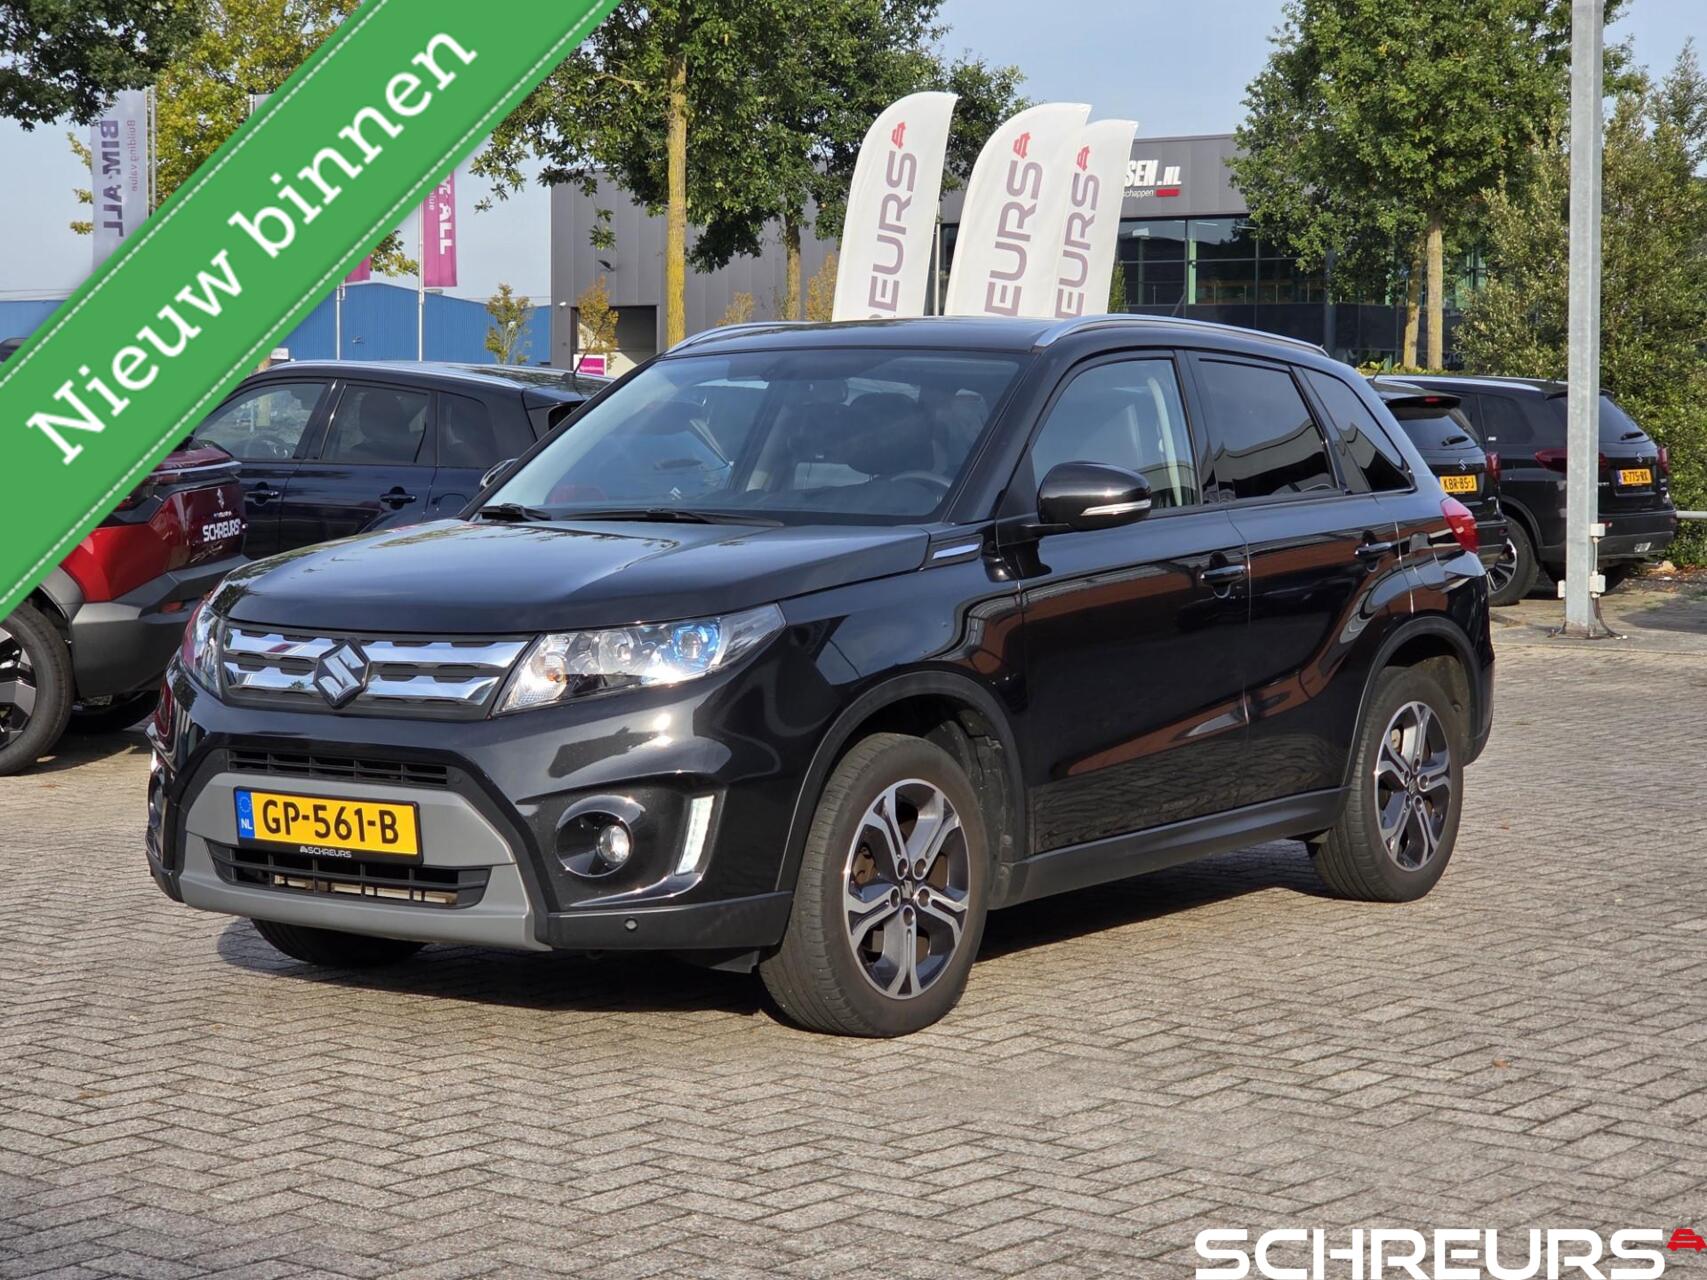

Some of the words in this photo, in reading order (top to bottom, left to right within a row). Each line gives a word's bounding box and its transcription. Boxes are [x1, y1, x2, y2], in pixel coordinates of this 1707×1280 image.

[202, 518, 241, 542] SCHREURS
[240, 817, 253, 830] NL
[262, 799, 399, 844] GP-561-B
[308, 846, 352, 858] SCHREURS
